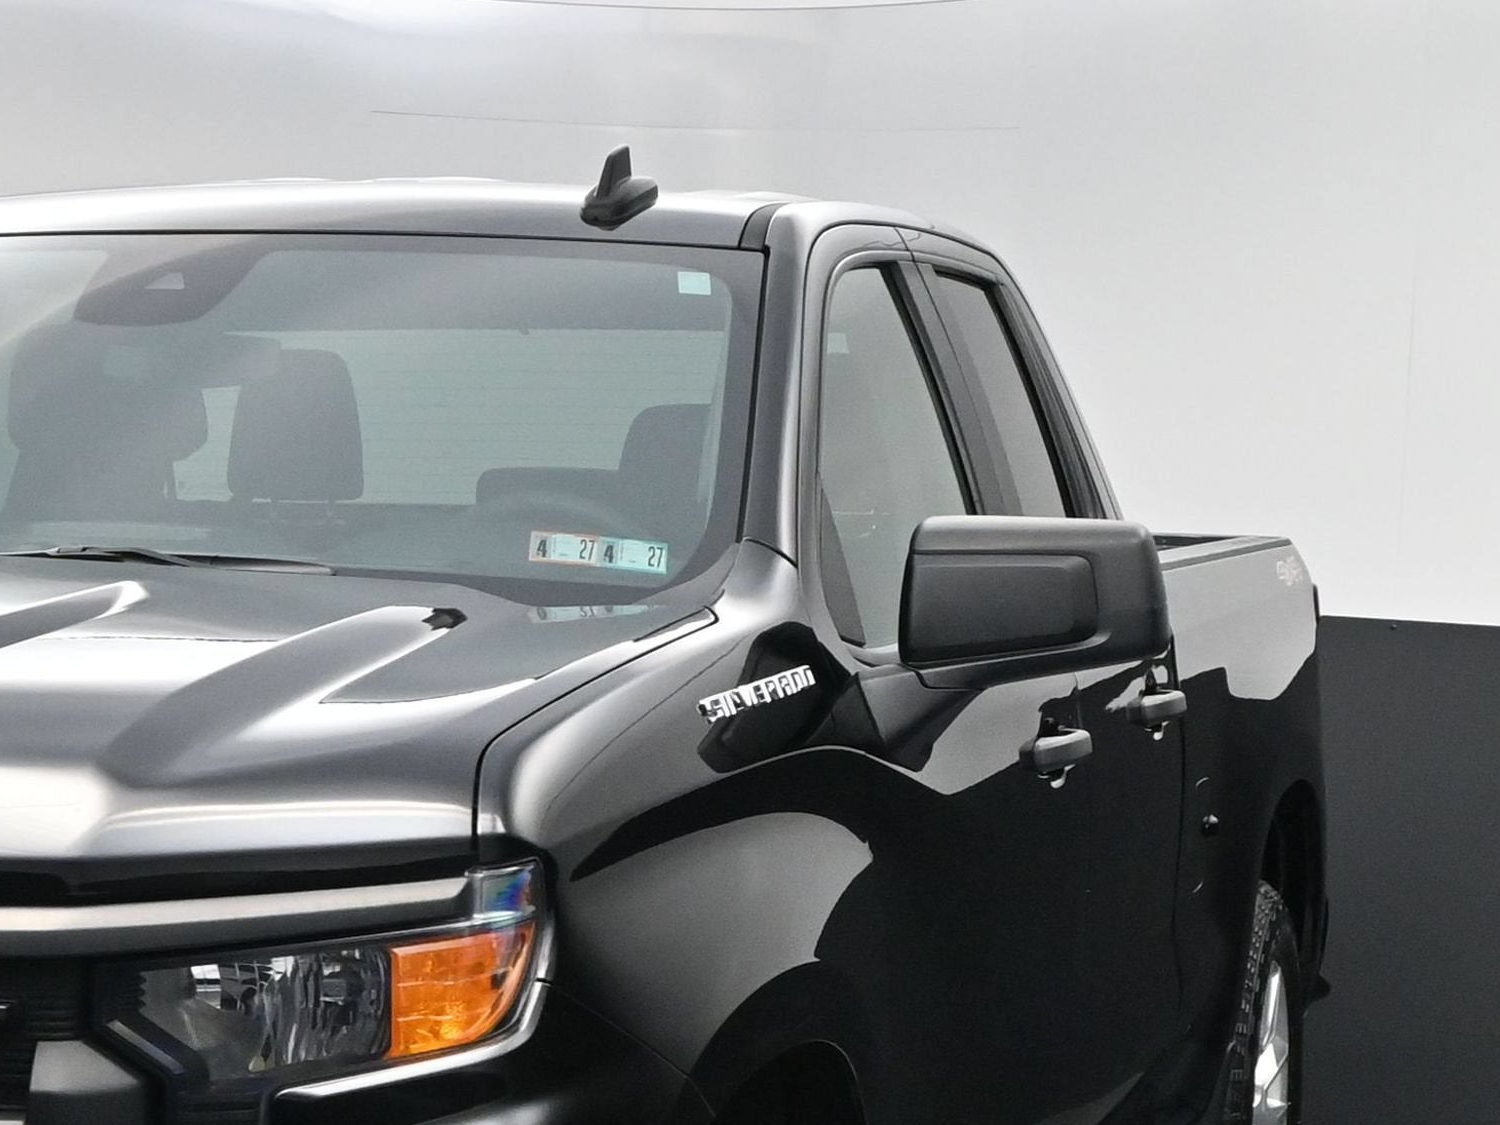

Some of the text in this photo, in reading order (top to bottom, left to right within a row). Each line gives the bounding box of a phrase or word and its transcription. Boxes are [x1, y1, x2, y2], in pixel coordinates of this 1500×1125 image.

[536, 539, 596, 561] 4 27
[603, 544, 663, 569] 4 27
